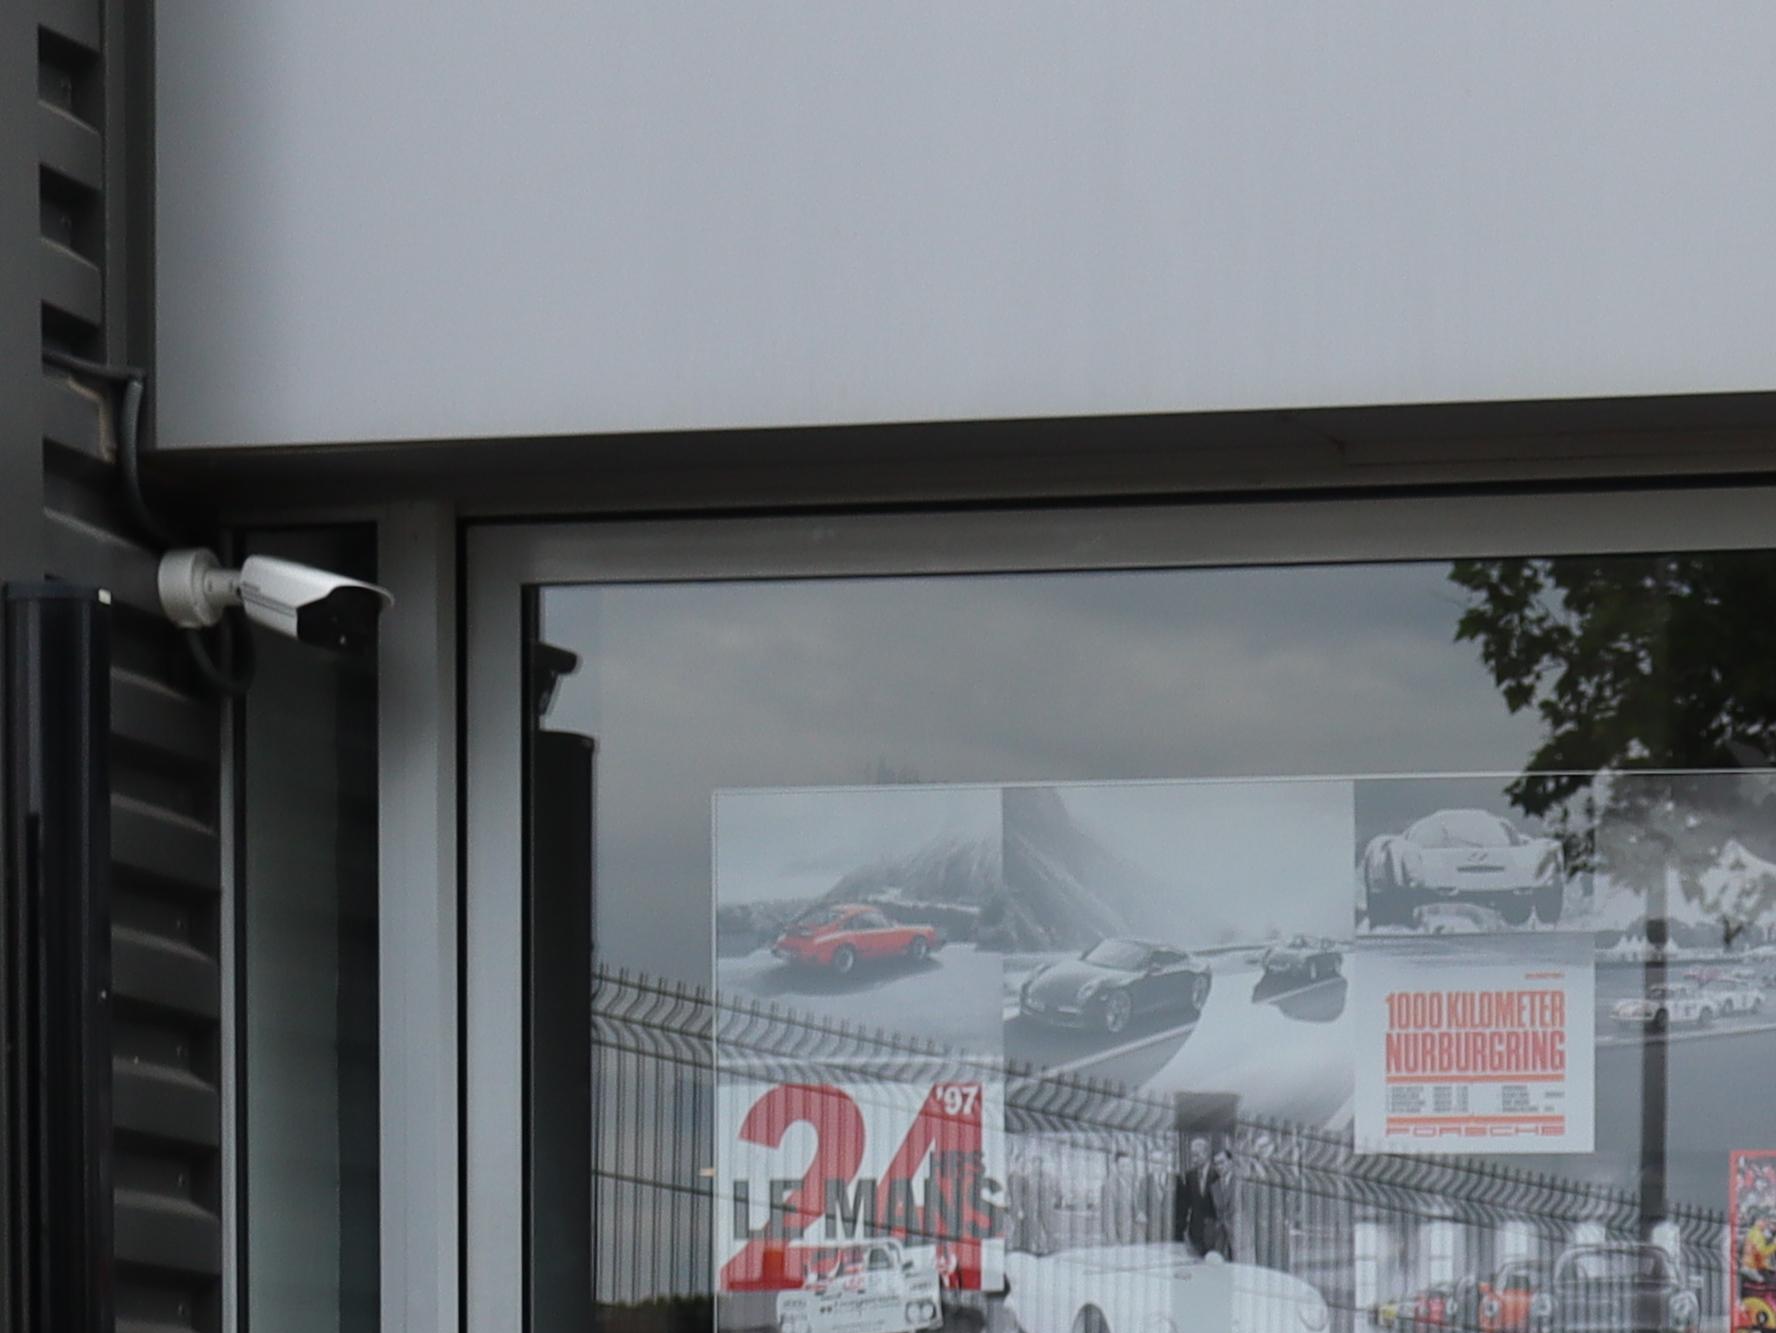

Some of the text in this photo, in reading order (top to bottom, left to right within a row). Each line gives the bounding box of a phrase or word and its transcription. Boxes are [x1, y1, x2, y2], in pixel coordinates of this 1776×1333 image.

[1385, 990, 1566, 1030] 1000 KILOMETER
[1385, 1030, 1566, 1073] NURBURGRING
[935, 1086, 979, 1115] '97
[1385, 1126, 1566, 1138] PORSCHE
[720, 1083, 983, 1291] 24
[733, 1178, 1004, 1245] LE MANS
